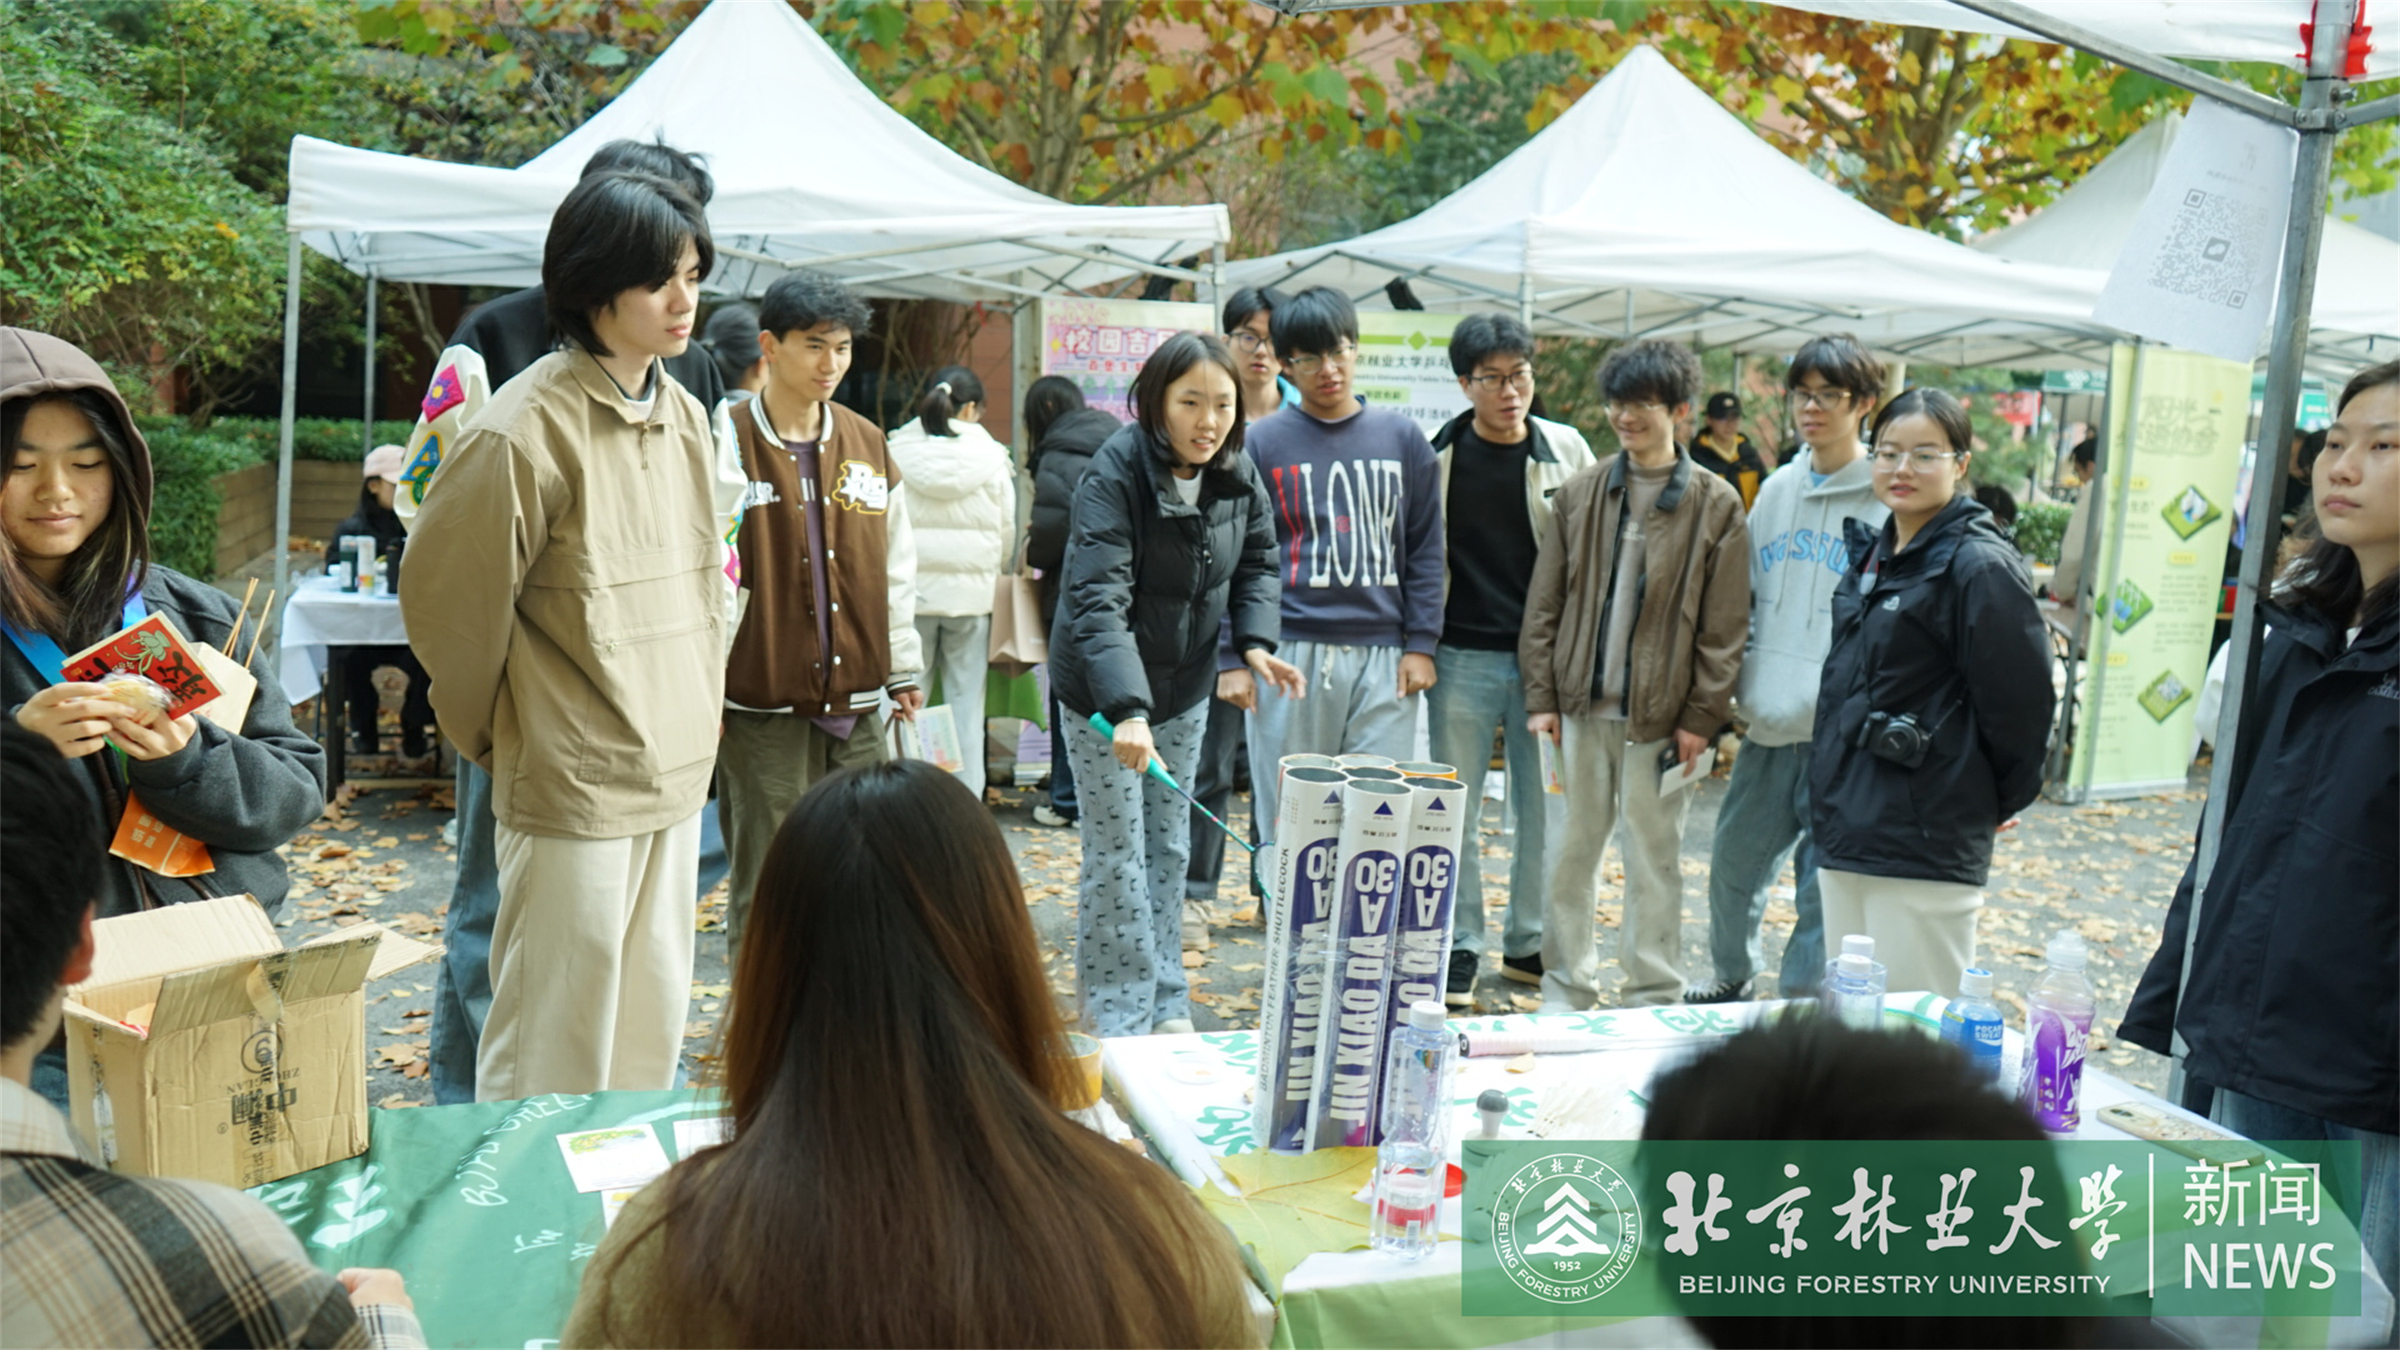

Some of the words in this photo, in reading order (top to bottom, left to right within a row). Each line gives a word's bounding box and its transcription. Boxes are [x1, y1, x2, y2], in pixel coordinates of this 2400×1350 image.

[1272, 459, 1403, 588] VLONE
[1272, 846, 1290, 946] SHUTTLECOCK
[1354, 857, 1396, 894] 30
[1409, 852, 1451, 889] 30
[1359, 894, 1387, 934] A
[1415, 888, 1442, 928] A
[1266, 948, 1280, 1009] FEATHER
[1347, 933, 1388, 979] DA
[1259, 1011, 1275, 1092] BADMINTON
[1336, 988, 1381, 1067] XIAO
